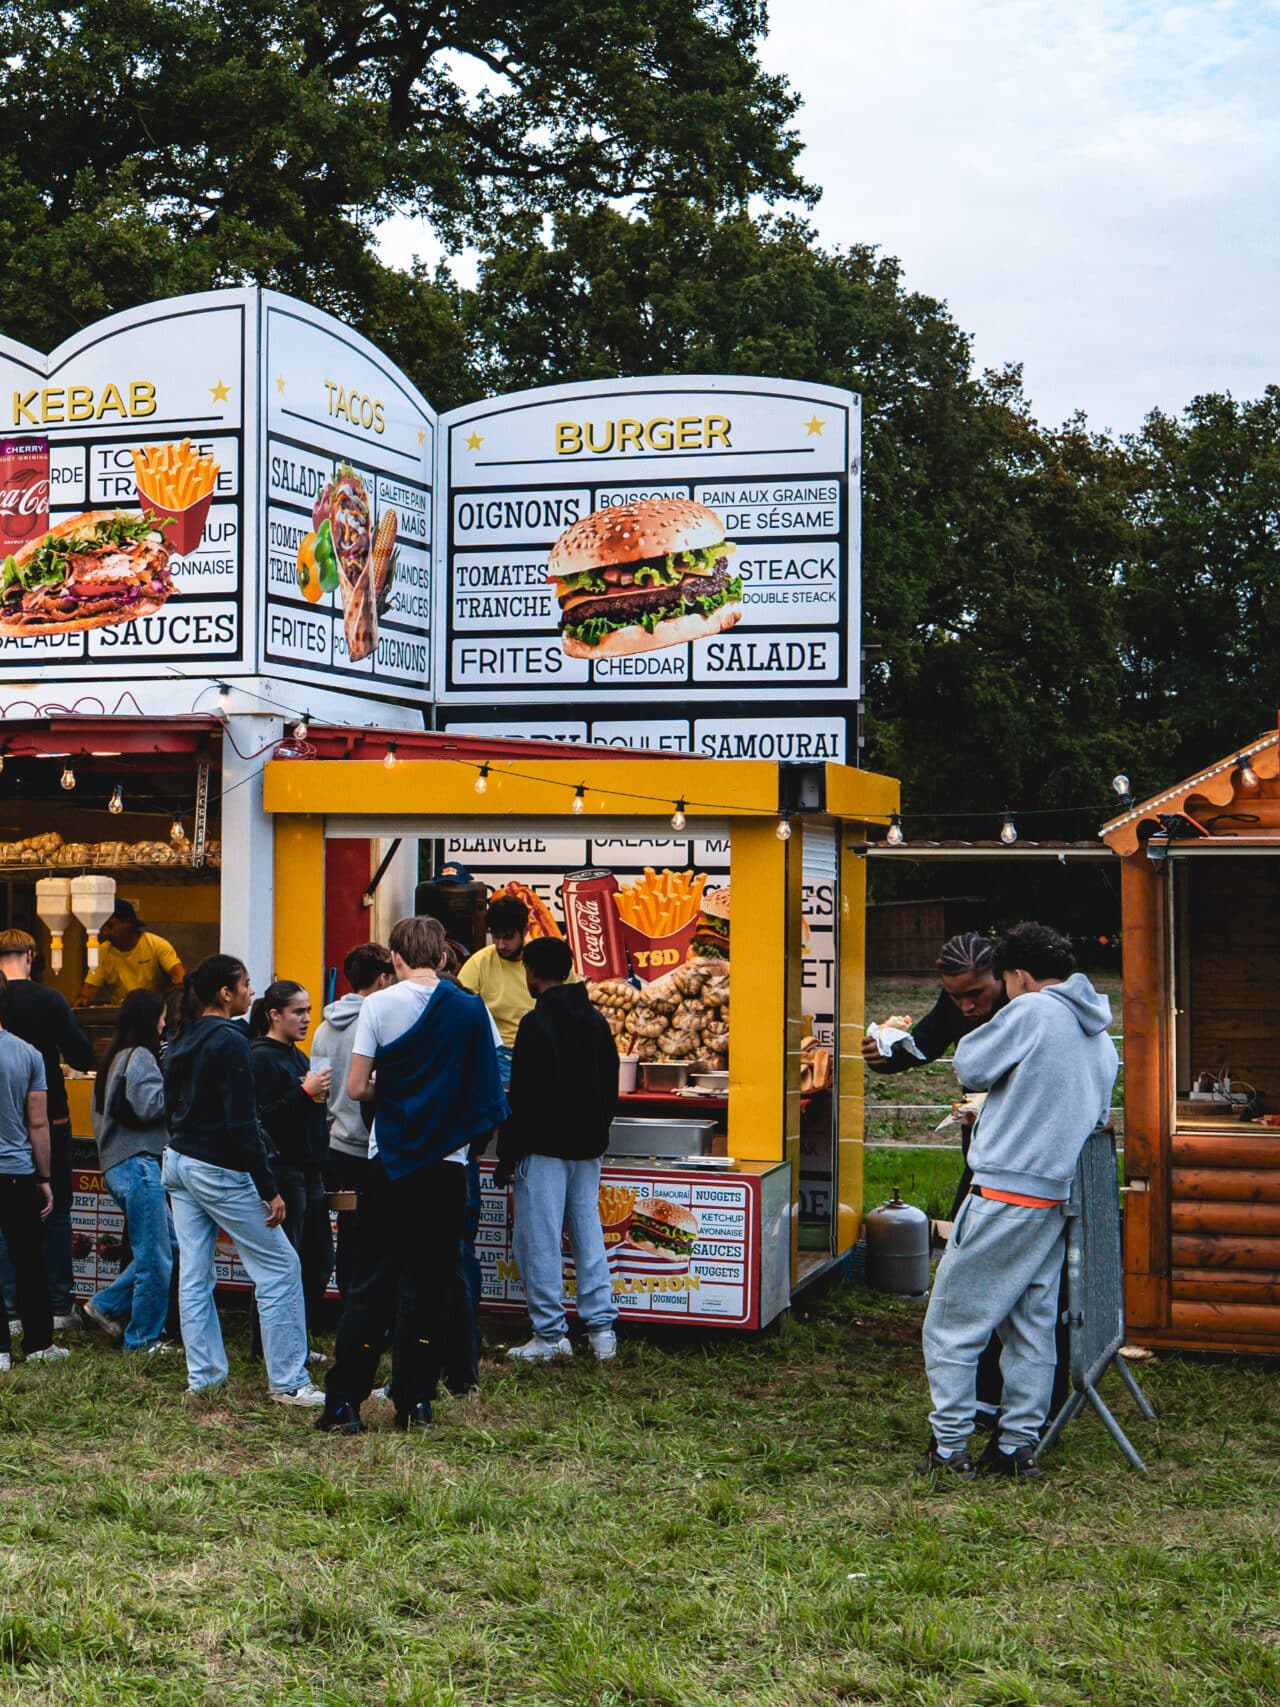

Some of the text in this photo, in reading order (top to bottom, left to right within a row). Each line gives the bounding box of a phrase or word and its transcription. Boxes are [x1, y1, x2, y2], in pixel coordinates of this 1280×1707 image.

[13, 381, 157, 425] KEBAB
[325, 380, 385, 434] TACOS
[555, 414, 732, 455] BURGER
[6, 445, 43, 454] CHERRY
[380, 483, 410, 505] GALETTE
[411, 492, 426, 510] PAIN
[703, 487, 837, 504] PAIN AUX GRAINES
[401, 513, 426, 537] MAÏS
[458, 498, 580, 531] OIGNONS
[726, 507, 834, 530] DE SÉSAME
[170, 560, 234, 576] ONNAISE
[270, 558, 298, 585] TRAN
[393, 563, 428, 589] VIANDES
[456, 563, 549, 588] TOMATES
[738, 558, 837, 581] STEACK
[395, 592, 428, 618] SAUCES
[456, 596, 552, 619] TRANCHE
[742, 591, 836, 605] DOUBLE STEACK
[100, 614, 234, 646] SAUCES
[271, 615, 326, 652] FRITES
[377, 634, 426, 673] OIGNONS
[461, 647, 563, 675] FRITES
[706, 642, 827, 673] SALADE
[595, 657, 685, 677] CHEDDAR
[701, 733, 840, 759] SAMOURAI
[576, 899, 607, 967] Coca-Cola
[633, 948, 680, 968] YSD
[73, 1196, 96, 1207] RRY
[480, 1200, 503, 1209] ATES
[696, 1191, 741, 1202] NUGGETS
[702, 1213, 744, 1223] KETCHUP
[699, 1228, 743, 1237] AYONNAISE
[693, 1244, 742, 1257] SAUCES
[98, 1266, 119, 1274] SALAD
[695, 1266, 739, 1278] NUGGETS
[612, 1276, 700, 1294] RATION
[652, 1295, 687, 1305] OIGNONS
